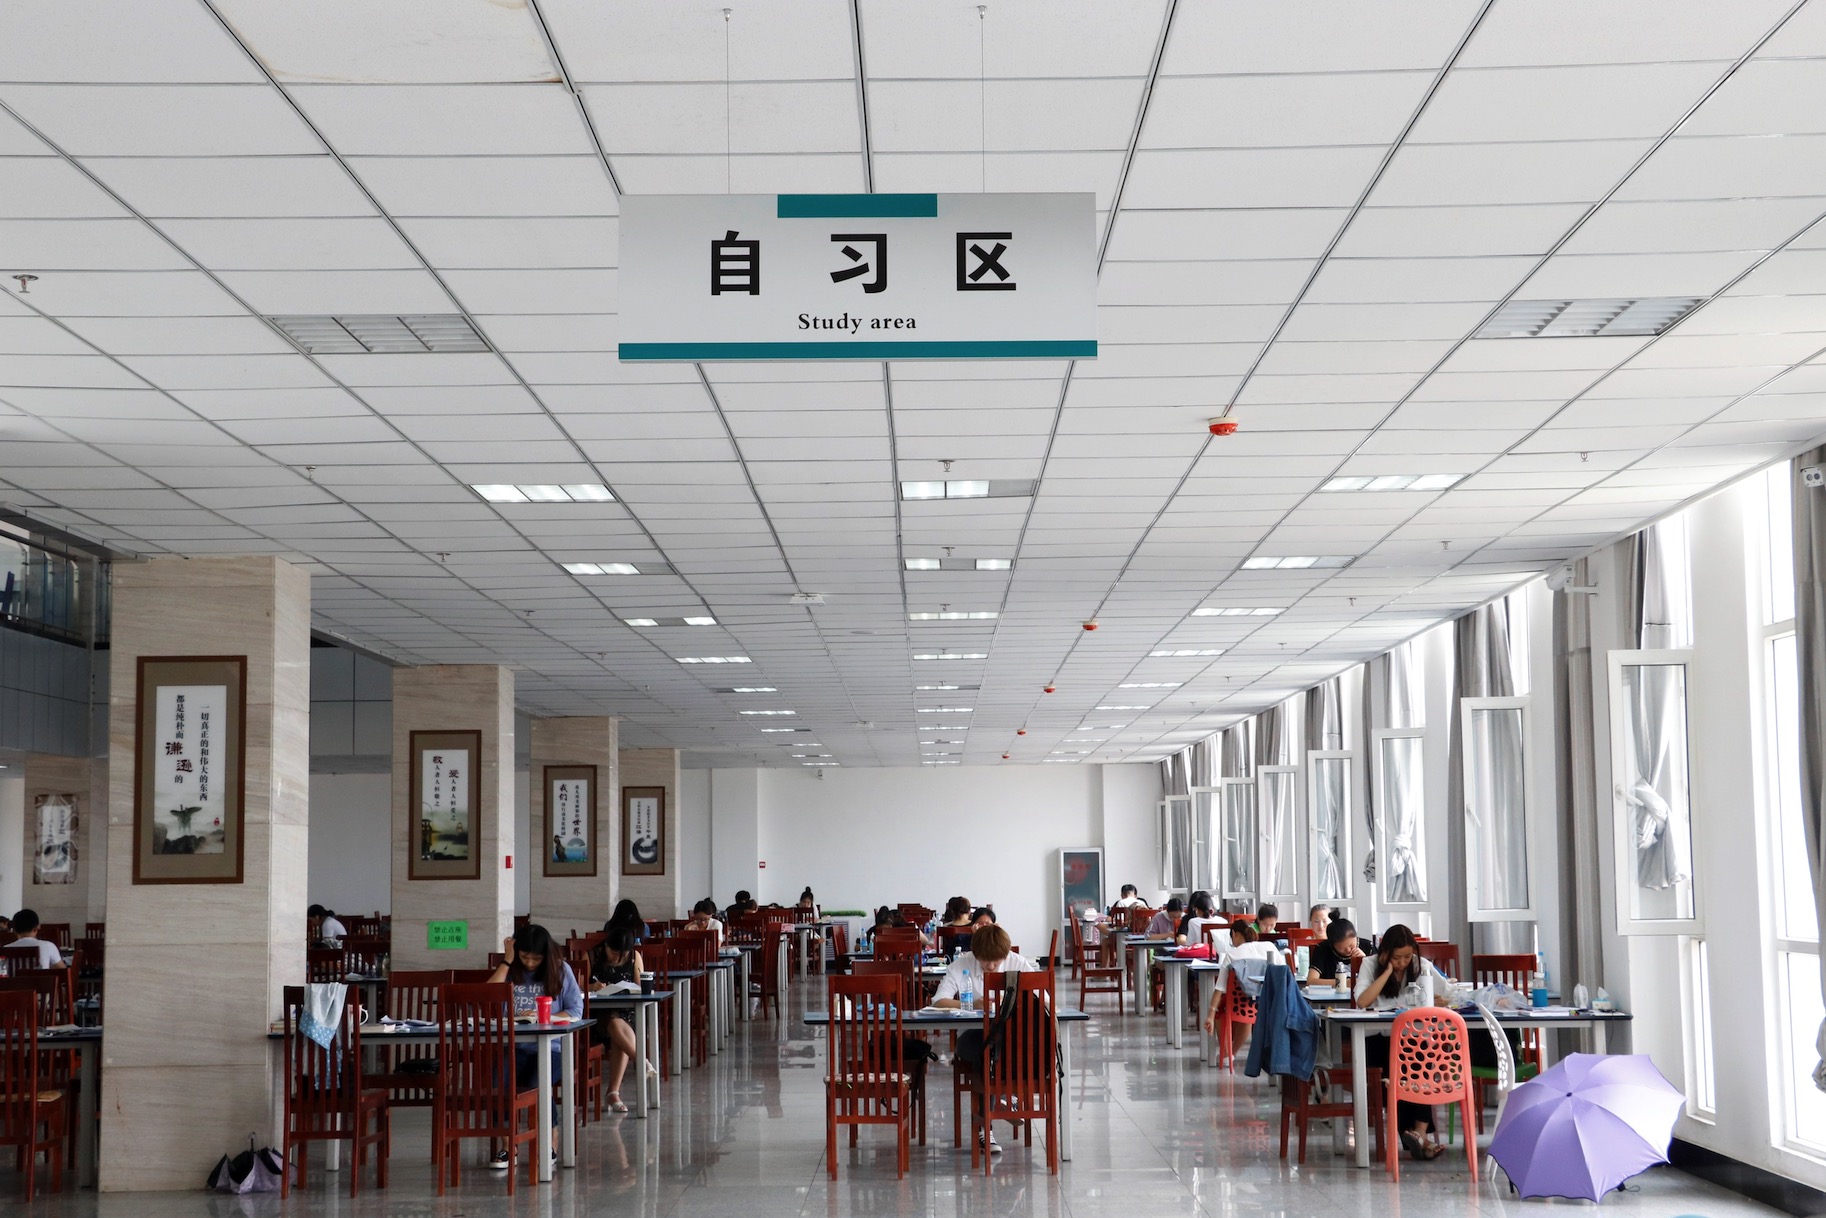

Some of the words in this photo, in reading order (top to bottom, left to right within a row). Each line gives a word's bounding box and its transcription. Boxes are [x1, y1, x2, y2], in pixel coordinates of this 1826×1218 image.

[710, 230, 1017, 296] 自习区
[798, 313, 864, 335] Study
[870, 315, 918, 330] area
[199, 705, 209, 801] 一切真正的和伟大的东西
